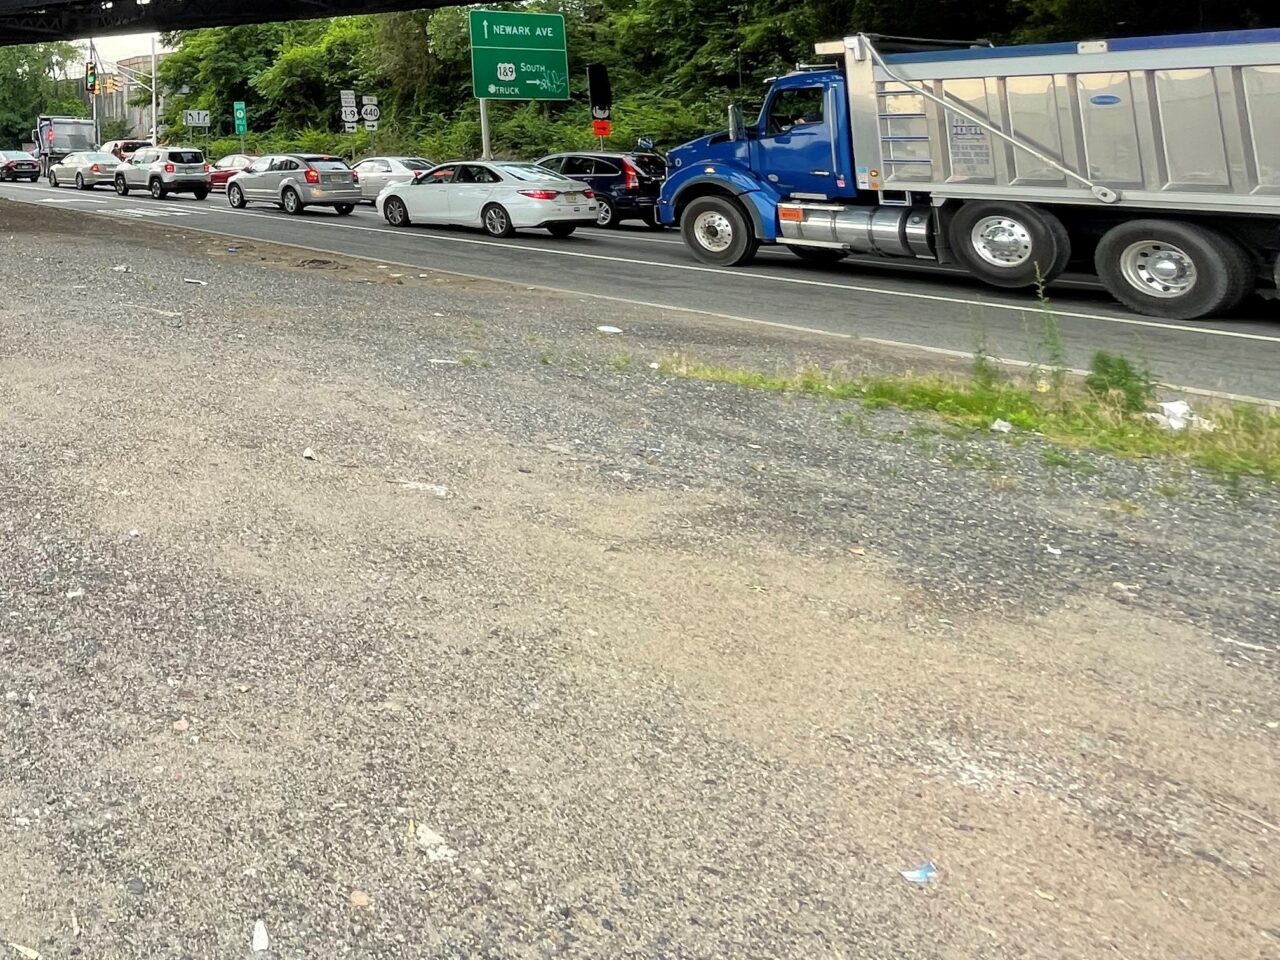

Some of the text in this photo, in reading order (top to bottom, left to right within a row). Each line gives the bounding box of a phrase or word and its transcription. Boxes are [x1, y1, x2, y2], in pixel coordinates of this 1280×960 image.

[493, 25, 554, 37] NEWARK AVE
[499, 65, 514, 77] 1&9
[520, 63, 546, 72] SOUTH
[495, 86, 520, 95] TRUCK
[344, 110, 356, 119] 1-9
[363, 108, 378, 117] 440
